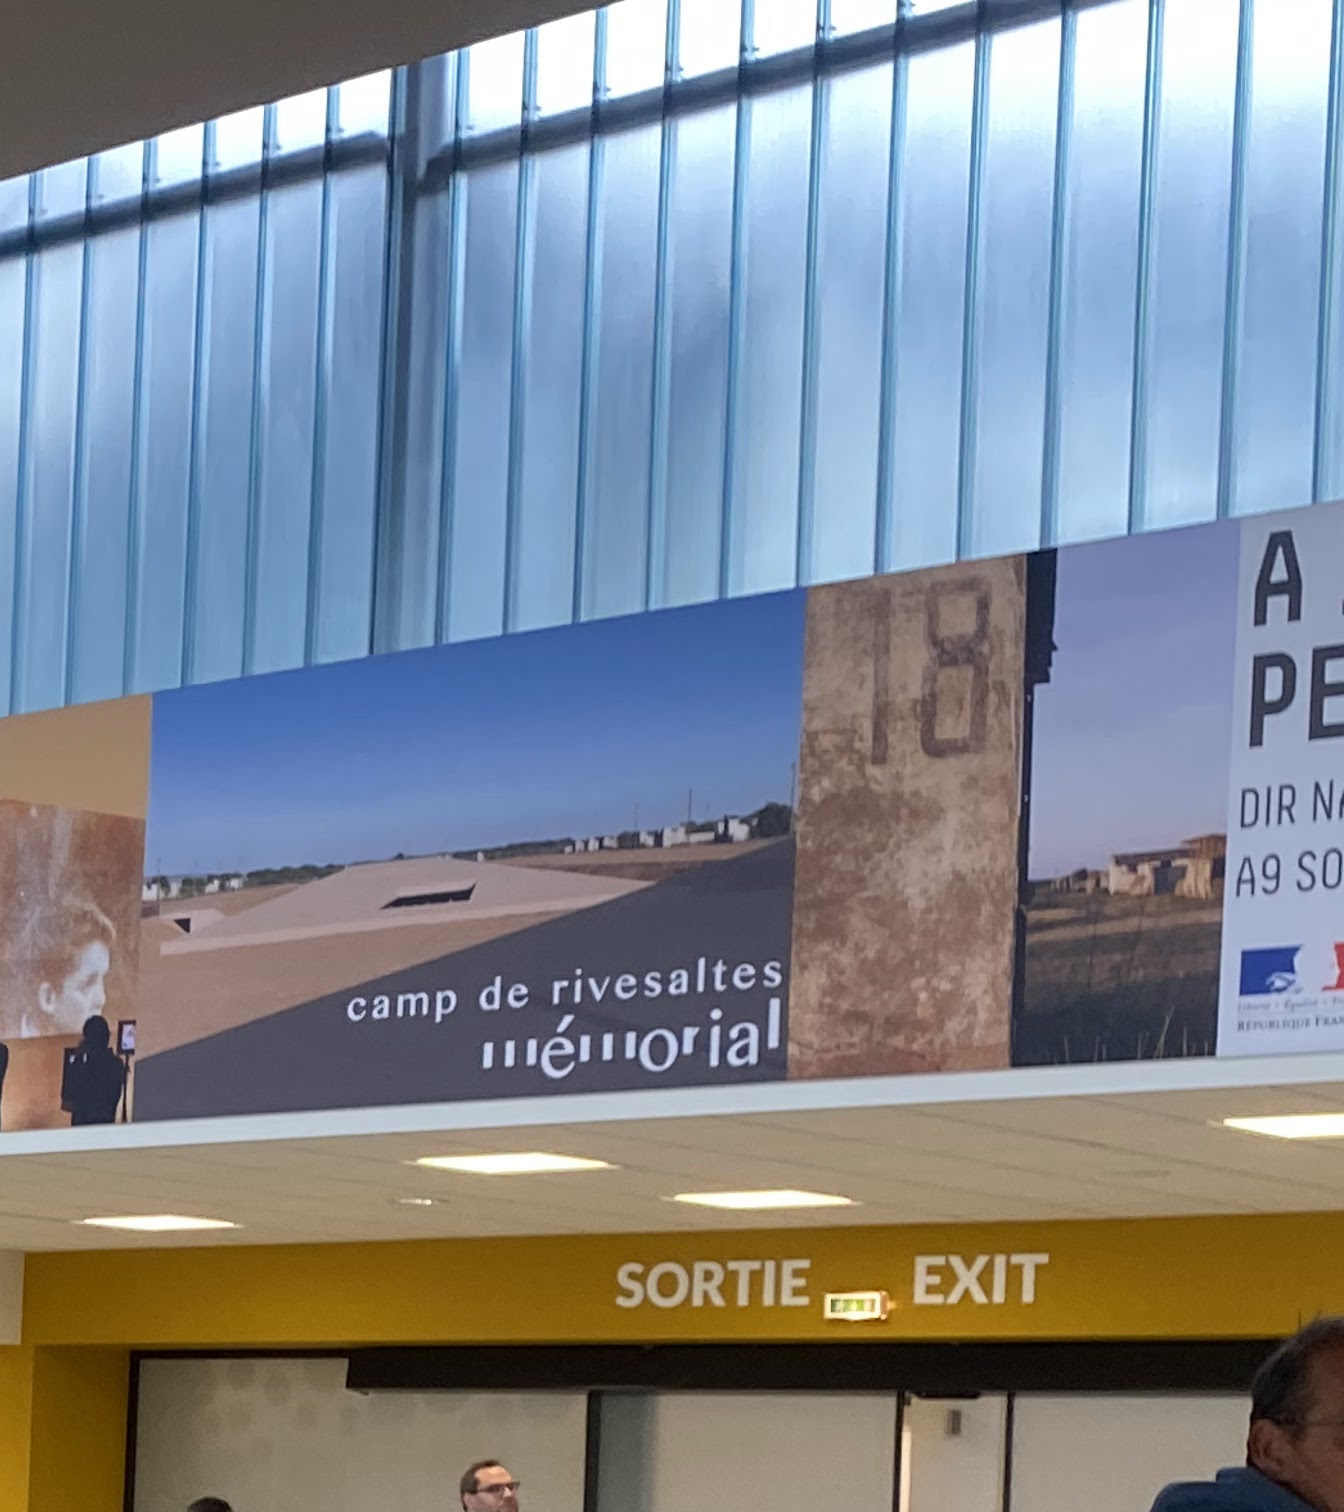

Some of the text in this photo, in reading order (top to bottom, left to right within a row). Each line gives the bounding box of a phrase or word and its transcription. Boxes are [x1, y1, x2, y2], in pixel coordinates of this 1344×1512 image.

[1254, 530, 1303, 627] A
[866, 577, 992, 766] 18
[1239, 783, 1296, 829] DIR
[1235, 852, 1281, 898] A9
[346, 956, 784, 1024] camp de rivesaltes
[481, 997, 781, 1080] mémorial
[614, 1252, 1050, 1309] SORTIE EXIT
